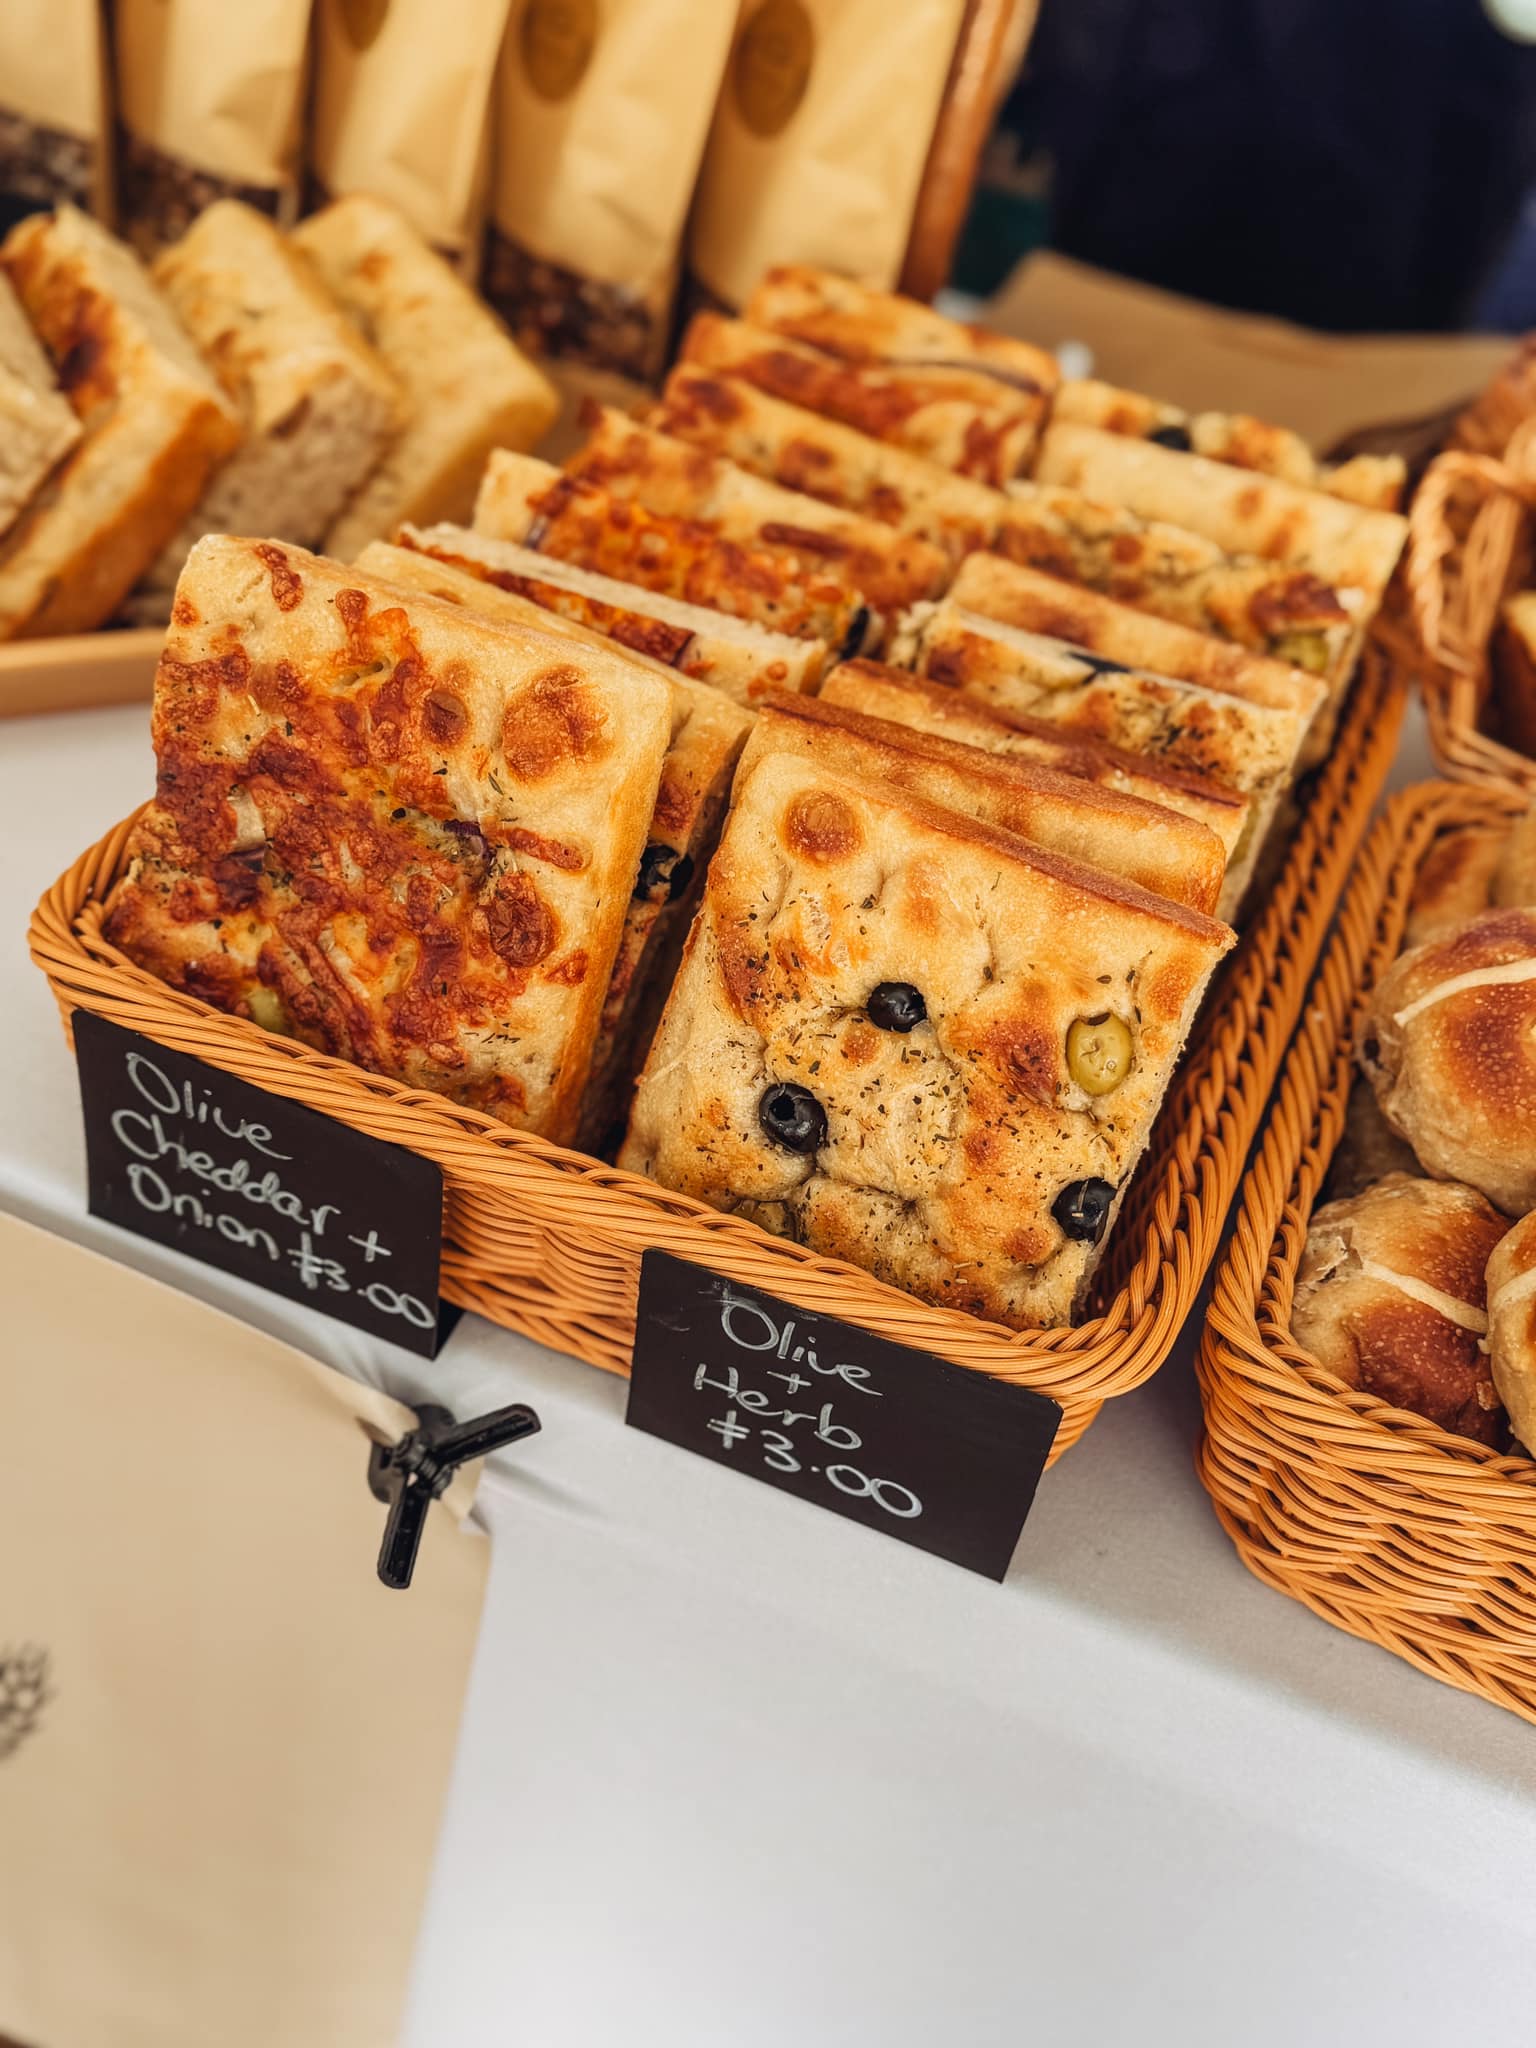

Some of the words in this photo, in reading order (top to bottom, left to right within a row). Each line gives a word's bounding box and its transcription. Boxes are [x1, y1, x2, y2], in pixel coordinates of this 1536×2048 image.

[126, 1052, 293, 1160] Olive
[111, 1109, 342, 1235] Cheddar
[348, 1230, 392, 1262] +
[127, 1163, 280, 1260] Onion
[721, 1299, 884, 1397] Olive
[767, 1370, 812, 1395] +
[693, 1363, 863, 1450] Herb
